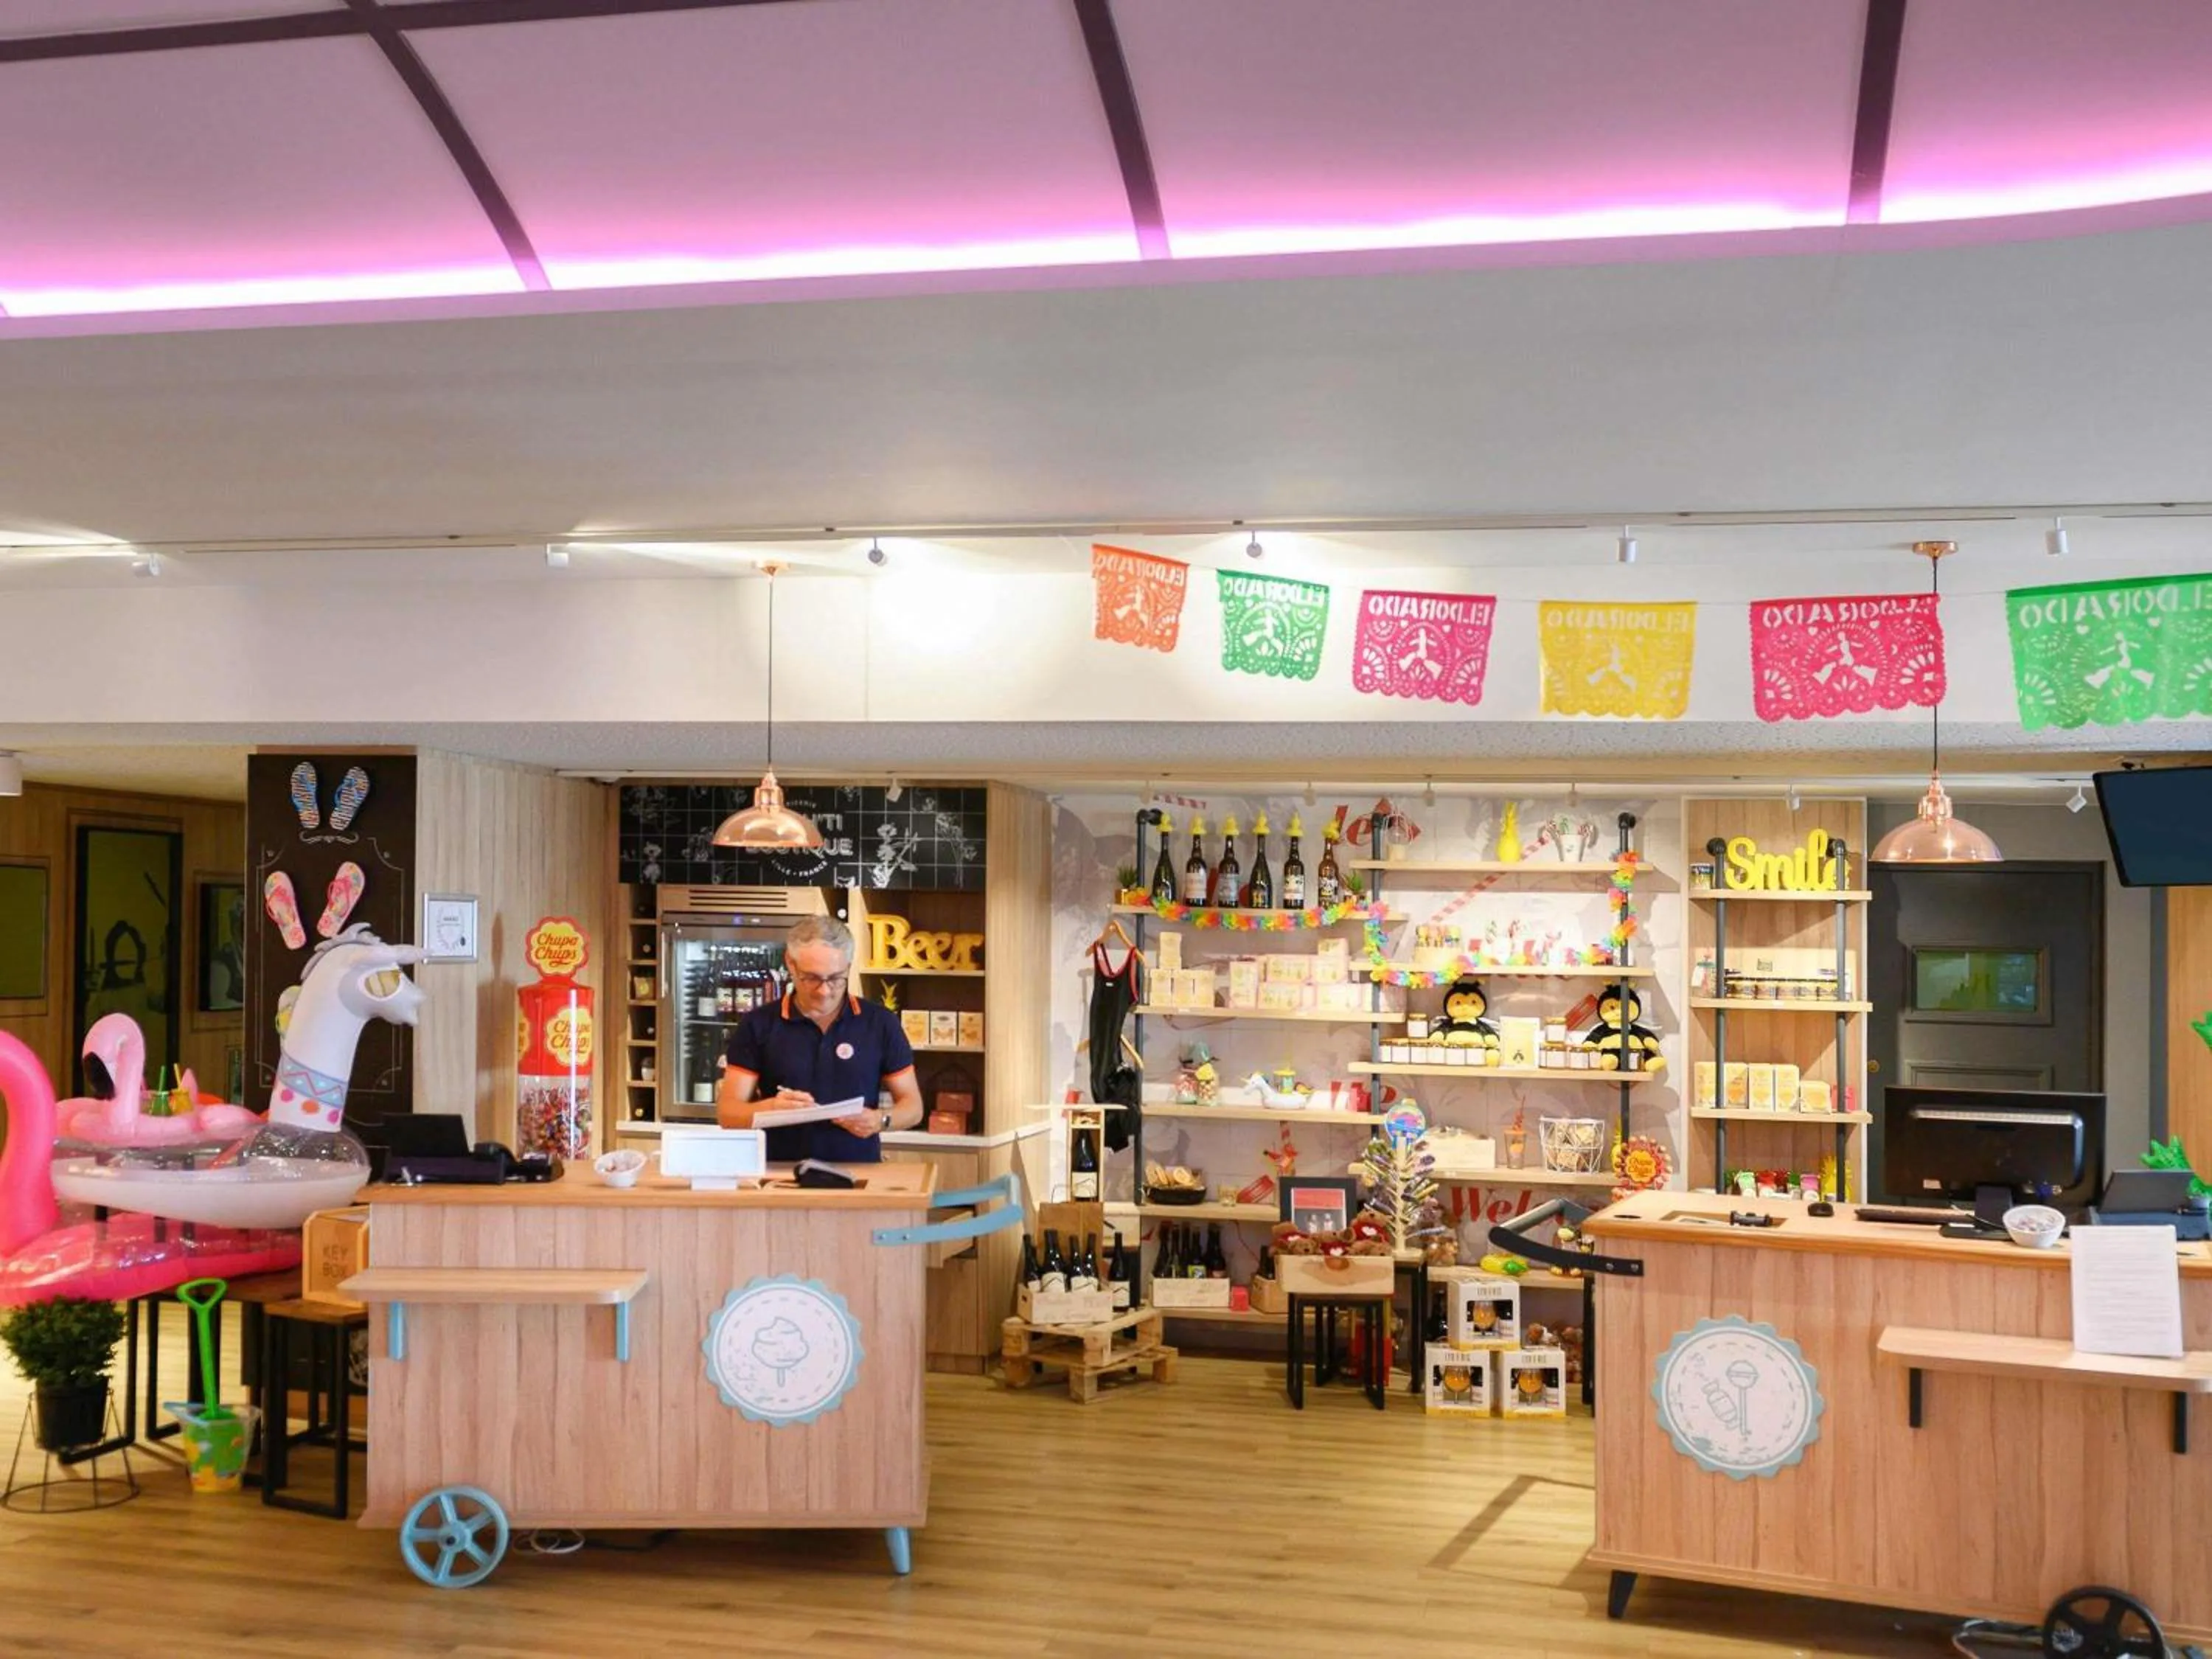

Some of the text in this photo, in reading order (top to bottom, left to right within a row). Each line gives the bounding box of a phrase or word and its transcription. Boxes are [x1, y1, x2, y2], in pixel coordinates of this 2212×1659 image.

[537, 932, 580, 948] Chupa
[866, 914, 984, 970] Beer
[535, 945, 577, 966] Chups
[323, 1244, 349, 1262] KEY
